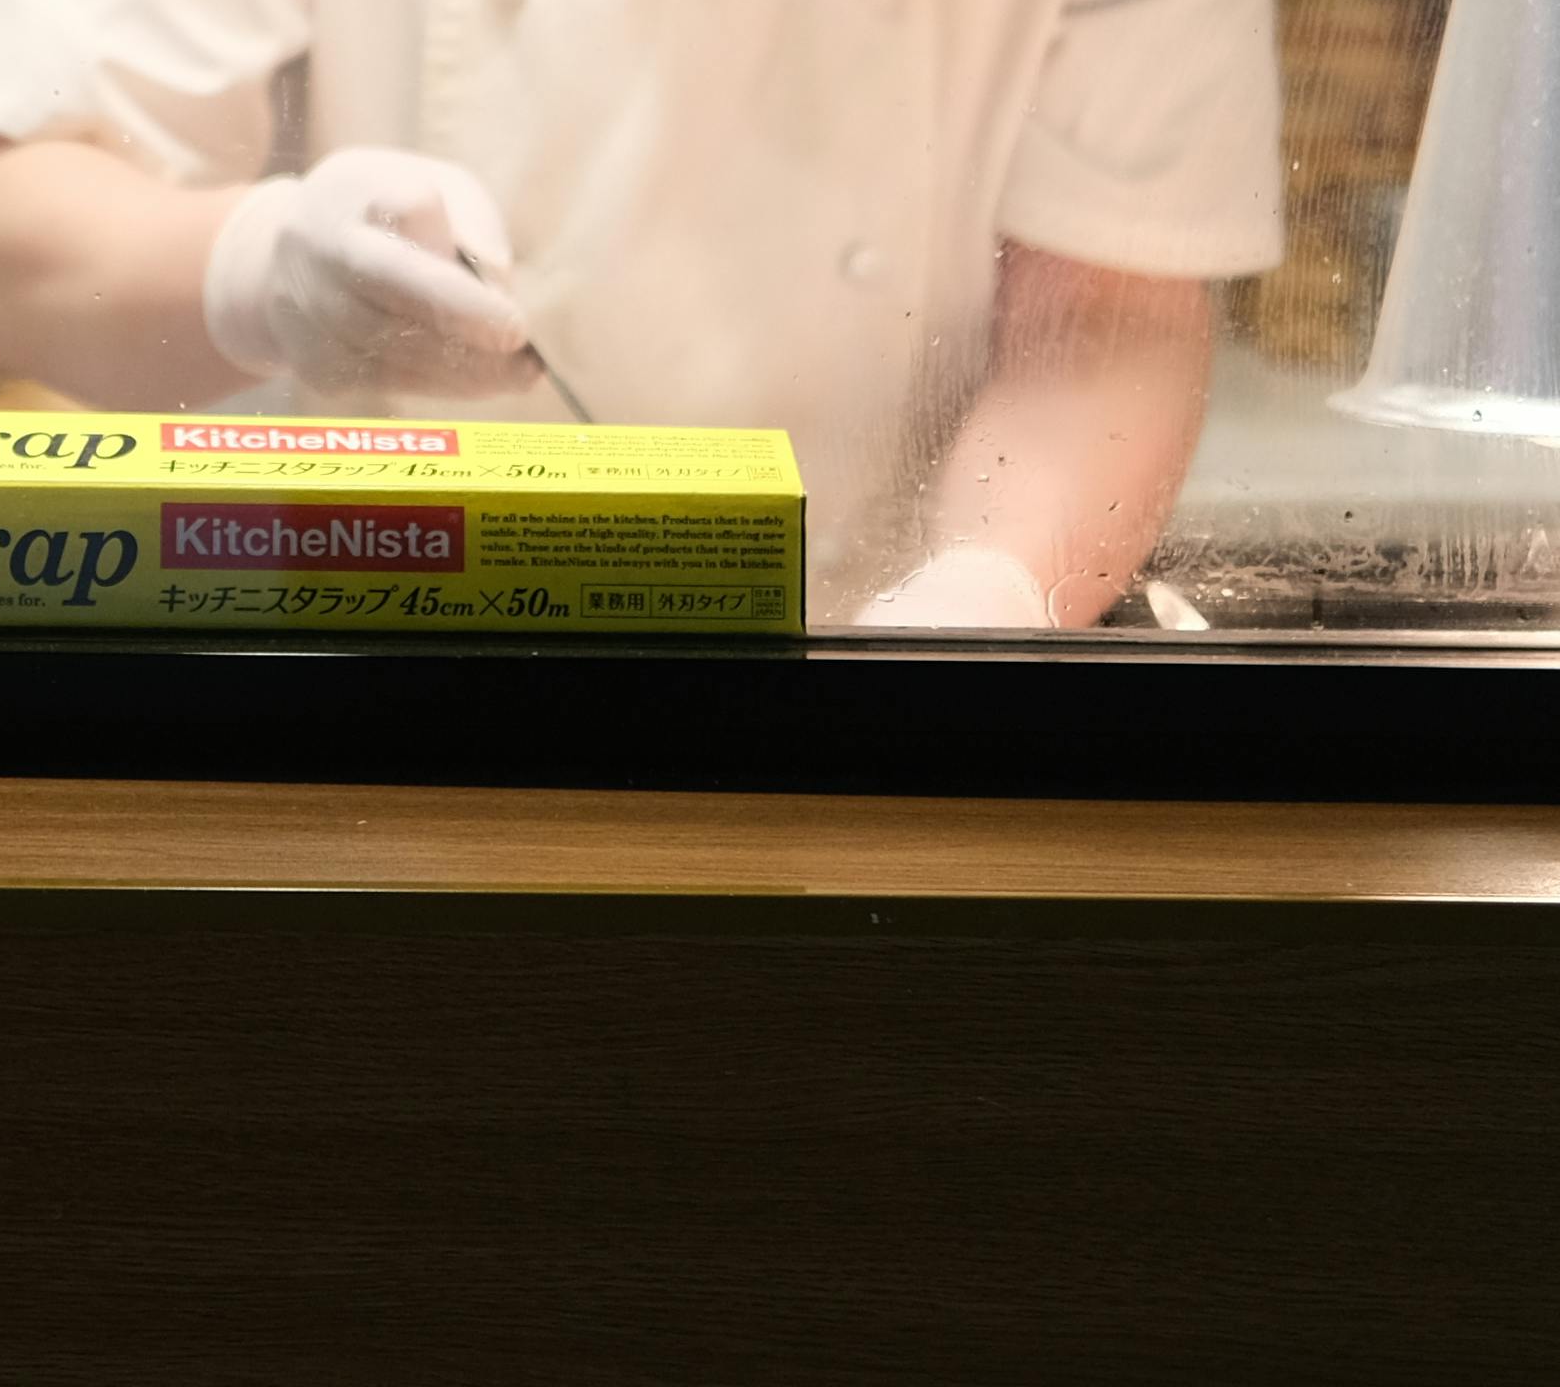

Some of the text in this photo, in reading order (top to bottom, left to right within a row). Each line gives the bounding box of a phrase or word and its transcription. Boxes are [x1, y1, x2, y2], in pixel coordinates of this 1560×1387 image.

[171, 428, 448, 454] KitcheNista
[159, 459, 395, 479] キッチニスタラップ
[174, 517, 452, 560] KitcheNista
[17, 592, 46, 607] for.
[159, 585, 398, 618] キッチニスタラップ
[588, 591, 645, 612] 業務用
[658, 592, 747, 613] 外刃タイプ
